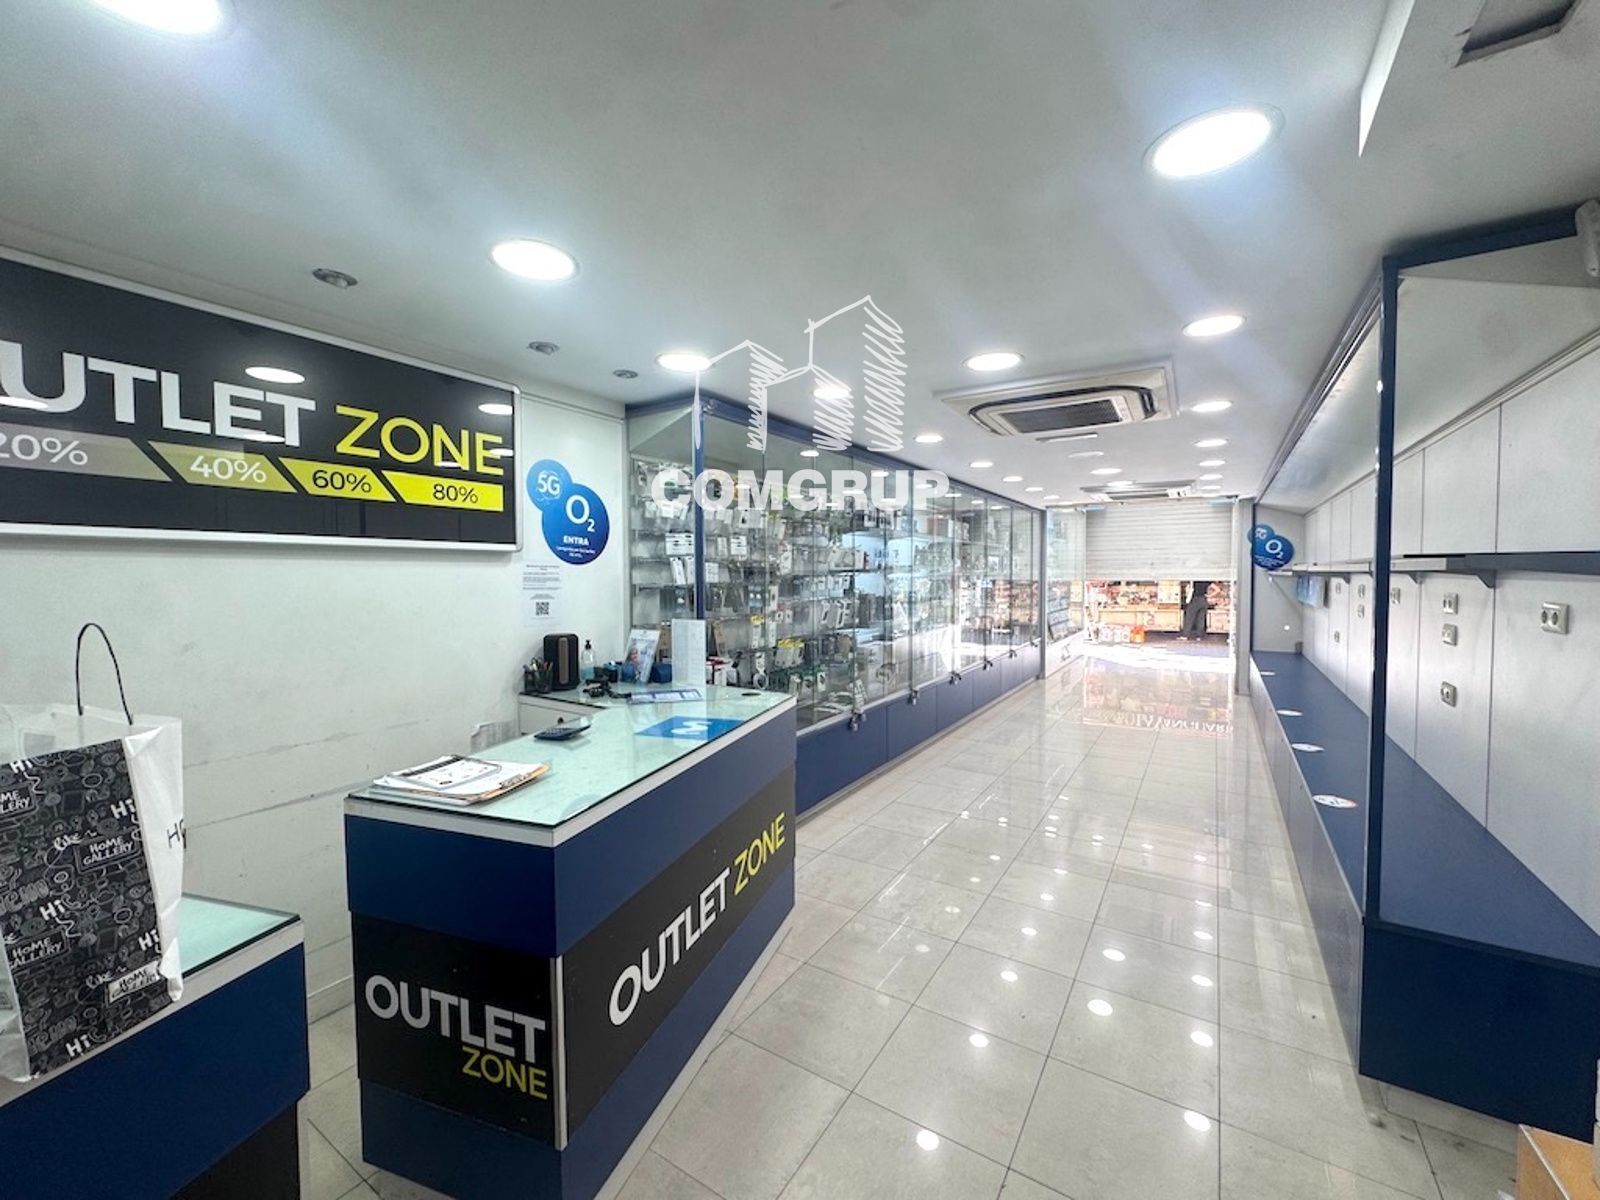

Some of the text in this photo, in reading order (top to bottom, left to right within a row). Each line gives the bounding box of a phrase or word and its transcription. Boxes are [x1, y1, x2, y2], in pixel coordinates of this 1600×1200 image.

[0, 340, 505, 476] UTLET ZONE
[190, 454, 268, 485] 40%
[312, 469, 373, 495] 60%
[537, 473, 561, 496] 5G
[433, 483, 479, 505] 80%
[563, 535, 590, 546] ENTRA
[0, 790, 21, 803] ME
[0, 797, 31, 814] LERY
[110, 798, 137, 820] Hi
[83, 841, 134, 866] GALLERY
[90, 836, 125, 853] HOME
[39, 899, 66, 922] Hi
[609, 811, 786, 1028] OUTLET ZONE
[12, 937, 52, 959] HOME
[138, 929, 160, 951] Hi
[365, 974, 546, 1064] OUTLET
[65, 1033, 92, 1057] Hi
[462, 1046, 548, 1100] ZONE
